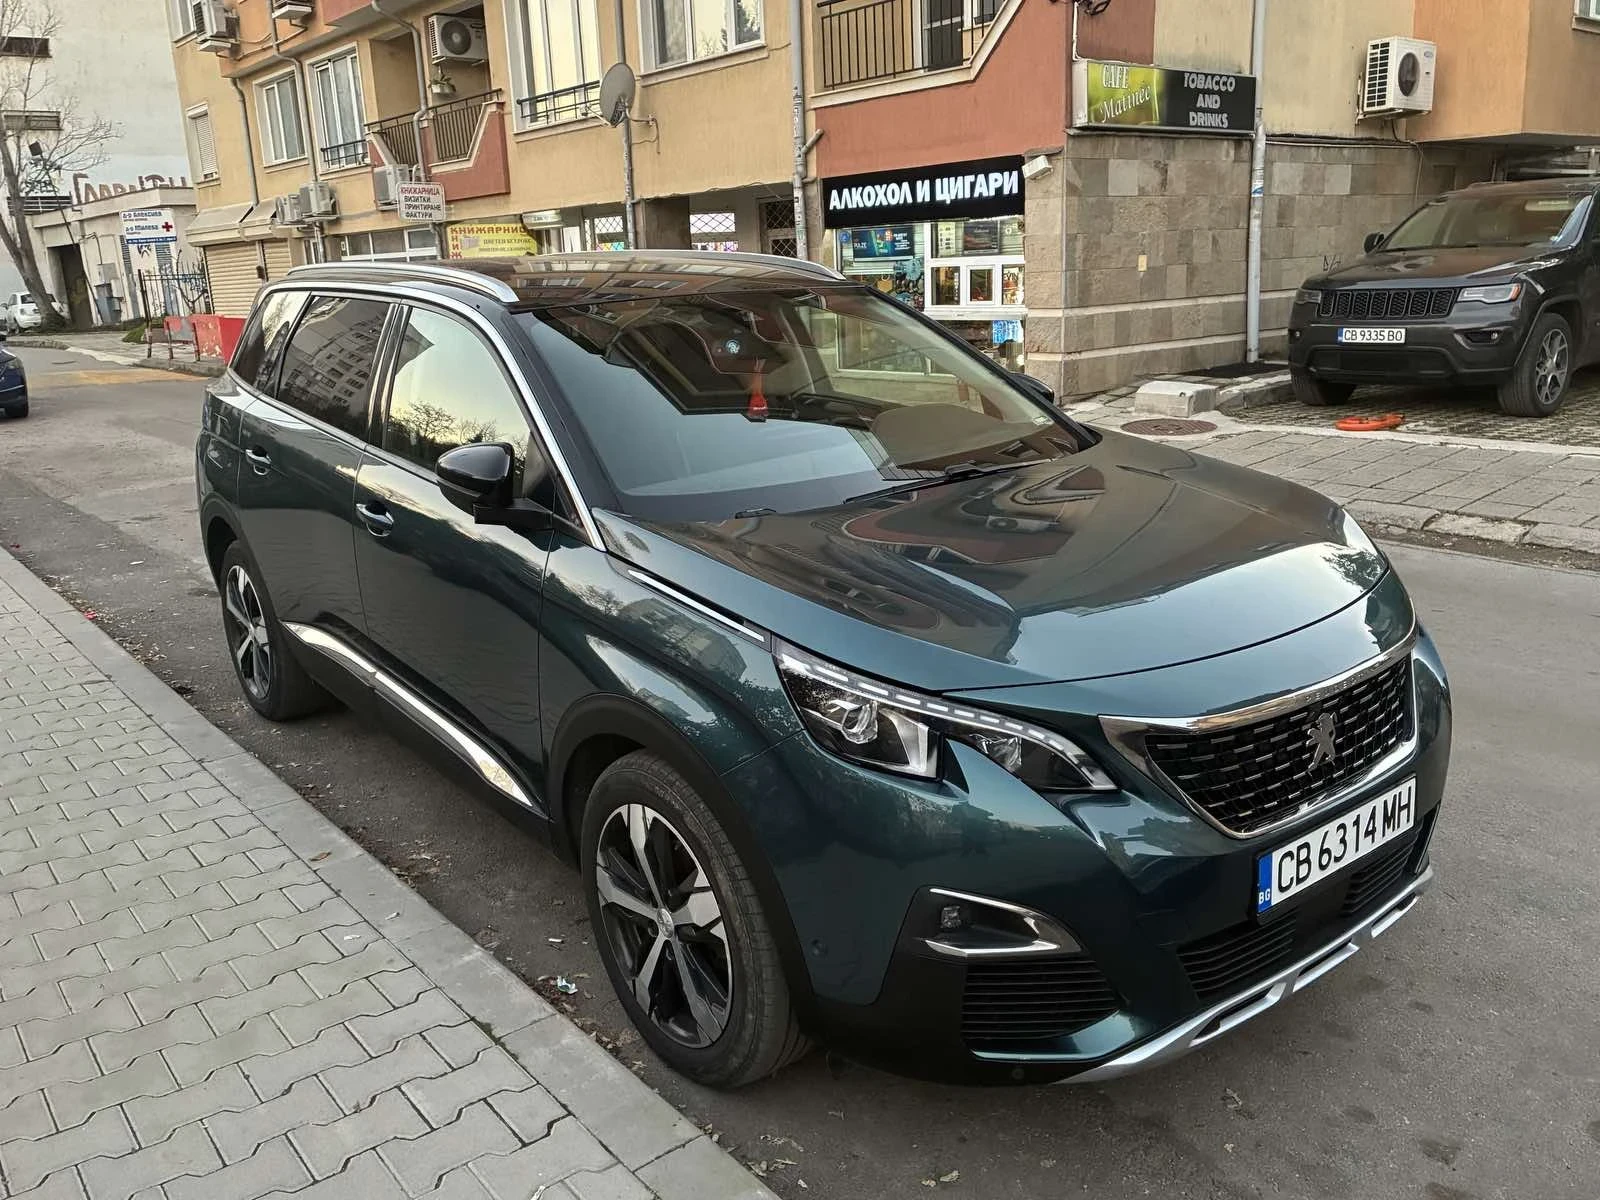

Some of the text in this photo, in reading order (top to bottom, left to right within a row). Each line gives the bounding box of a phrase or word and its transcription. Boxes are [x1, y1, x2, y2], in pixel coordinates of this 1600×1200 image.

[1103, 64, 1128, 88] CAFE
[1184, 72, 1236, 92] TOBACCO
[1196, 94, 1220, 109] AND
[1189, 111, 1229, 129] DRINKS
[401, 186, 441, 196] КНИЖАРНИЦА
[829, 170, 1019, 210] АЛКОХОЛ И ЦИГАРИ
[404, 195, 431, 203] ВИЗИТКИ
[405, 203, 441, 211] ПРИНТИРАНЕ
[405, 211, 433, 219] ФАКТУРИ
[1344, 330, 1357, 341] CB
[1360, 330, 1386, 341] 9335
[1277, 786, 1411, 893] CB 6314 MH
[1258, 889, 1271, 904] BG
